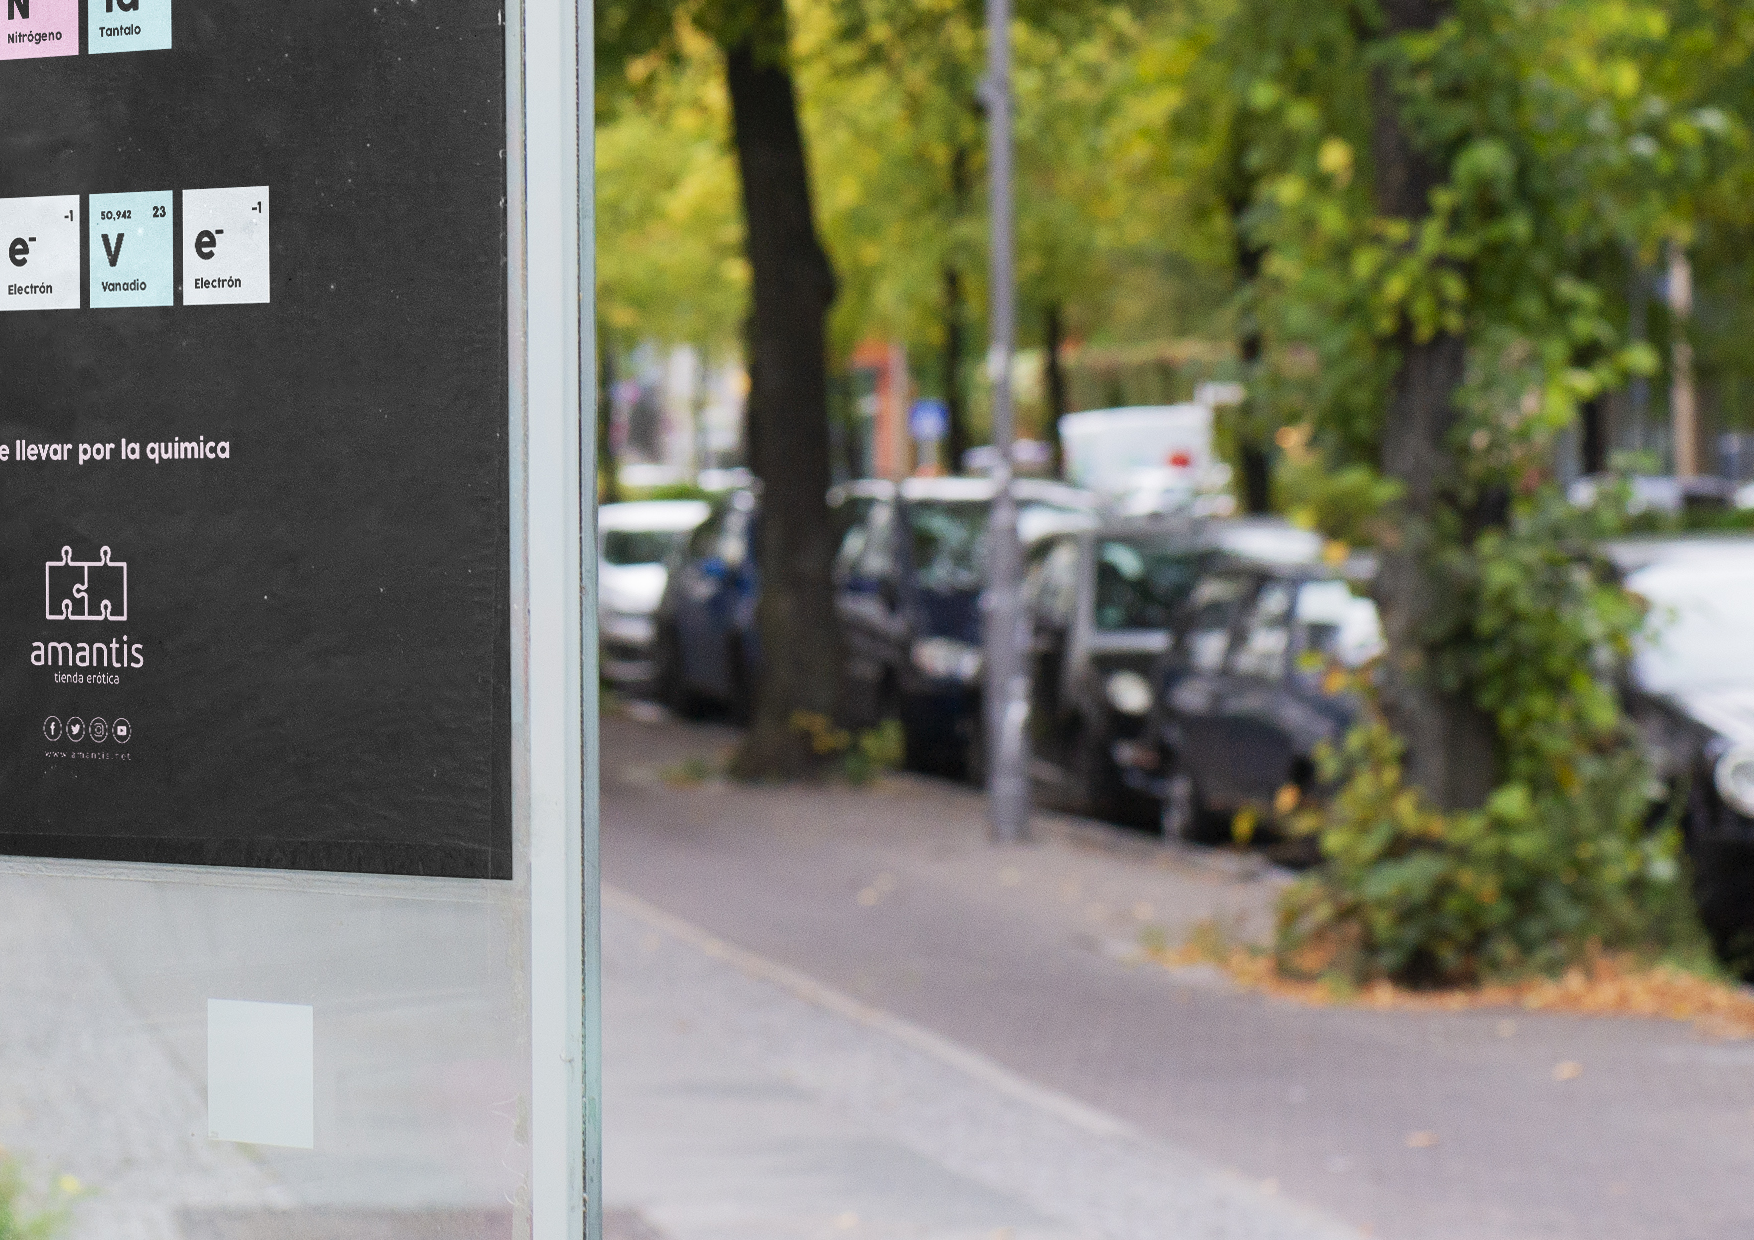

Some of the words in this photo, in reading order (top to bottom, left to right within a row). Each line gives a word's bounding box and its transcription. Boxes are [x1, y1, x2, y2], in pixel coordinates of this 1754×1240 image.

[99, 24, 141, 37] Tantalo
[8, 32, 62, 44] Nitrógeno
[101, 210, 131, 221] 50,942
[153, 206, 166, 217] 23
[101, 233, 124, 267] V
[8, 282, 52, 295] Electrón
[102, 280, 146, 292] Vanadio
[195, 276, 241, 289] Electrón
[16, 440, 72, 460] llevar
[79, 443, 115, 465] por
[122, 438, 139, 459] la
[147, 436, 229, 464] química
[31, 635, 143, 667] amantis
[55, 672, 83, 683] tienda
[87, 674, 119, 684] erótica
